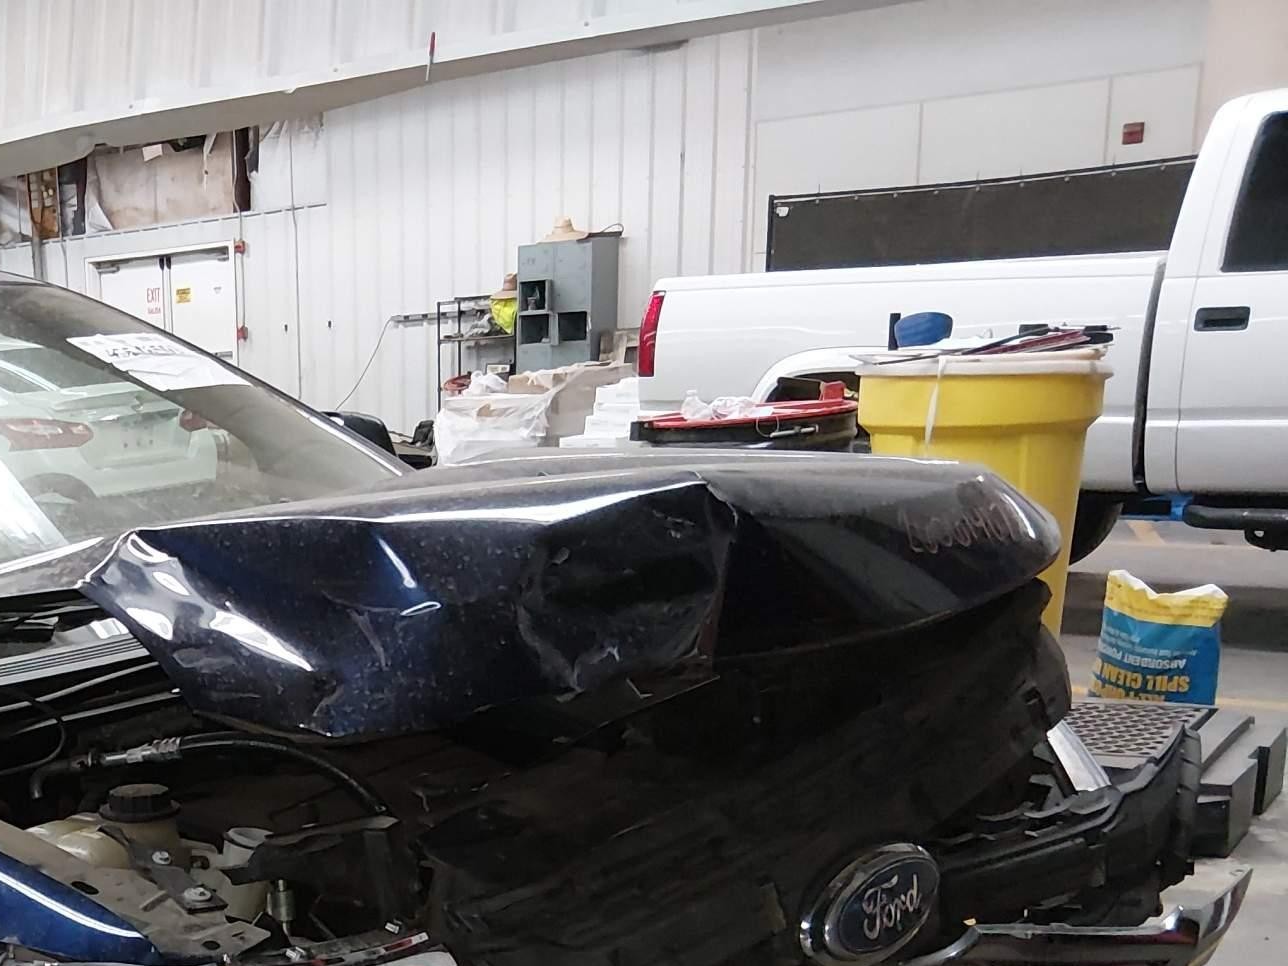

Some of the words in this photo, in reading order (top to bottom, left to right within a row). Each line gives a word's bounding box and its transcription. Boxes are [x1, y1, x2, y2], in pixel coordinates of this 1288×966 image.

[146, 287, 161, 304] EXIT
[1101, 661, 1143, 688] CLEAN
[1146, 674, 1190, 693] SPILL
[862, 874, 922, 940] Ford
